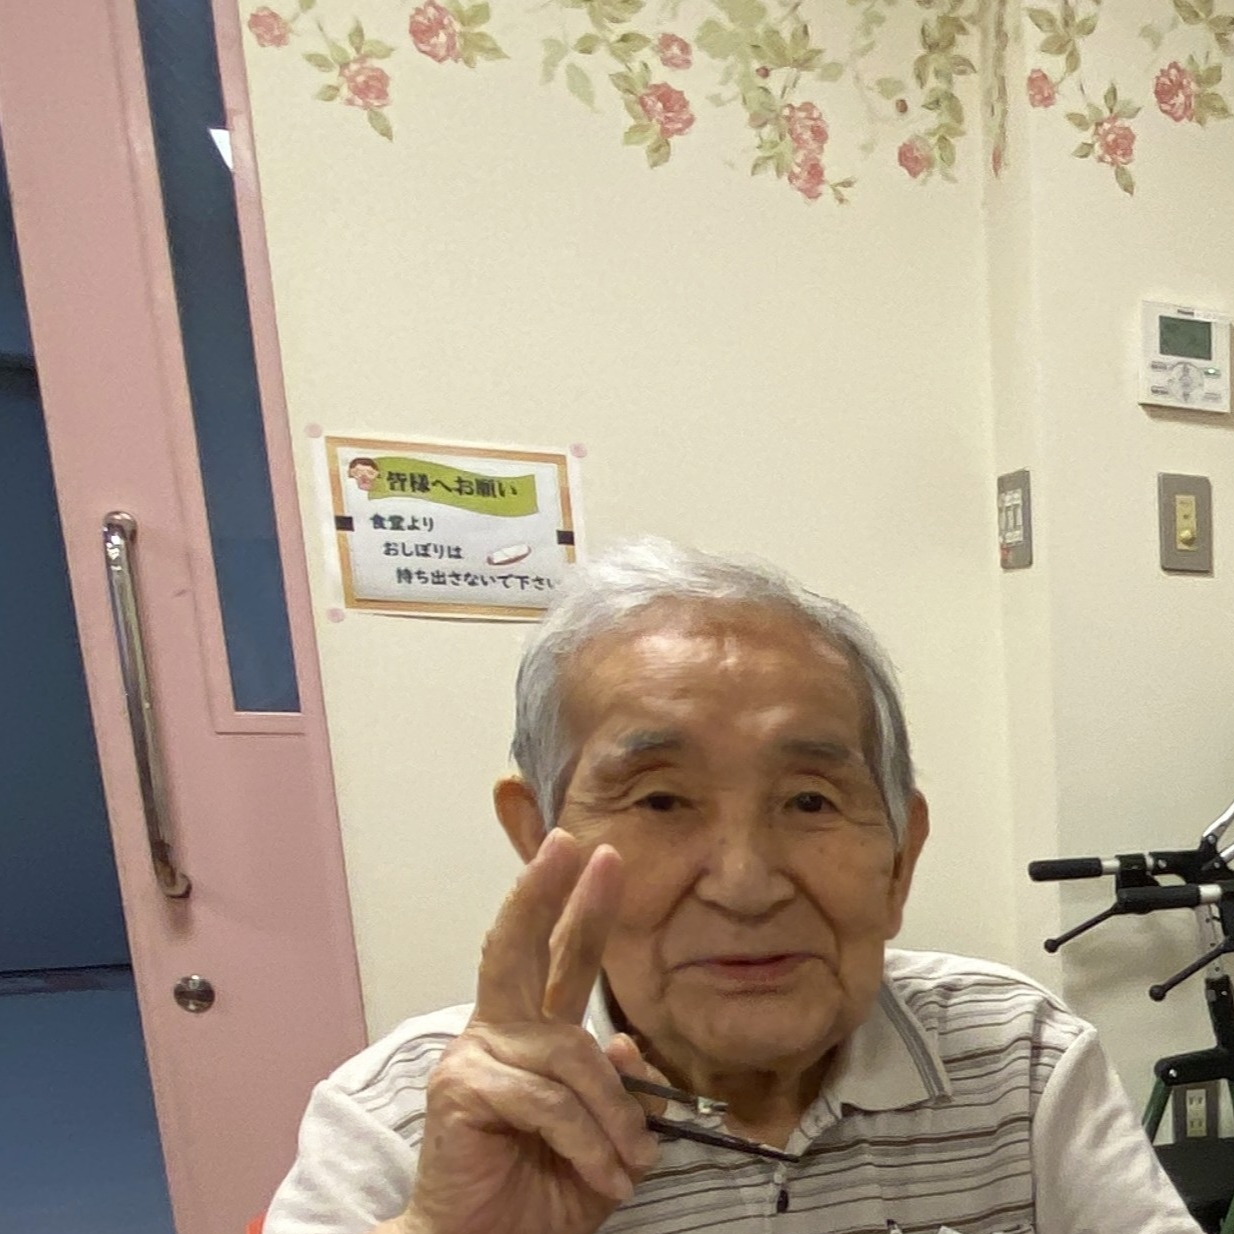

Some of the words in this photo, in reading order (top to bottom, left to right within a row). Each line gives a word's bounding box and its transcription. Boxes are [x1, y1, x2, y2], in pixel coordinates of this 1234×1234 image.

[386, 470, 518, 498] 皆様へお願い
[370, 513, 434, 532] 食堂より
[383, 541, 464, 559] おしぼりは
